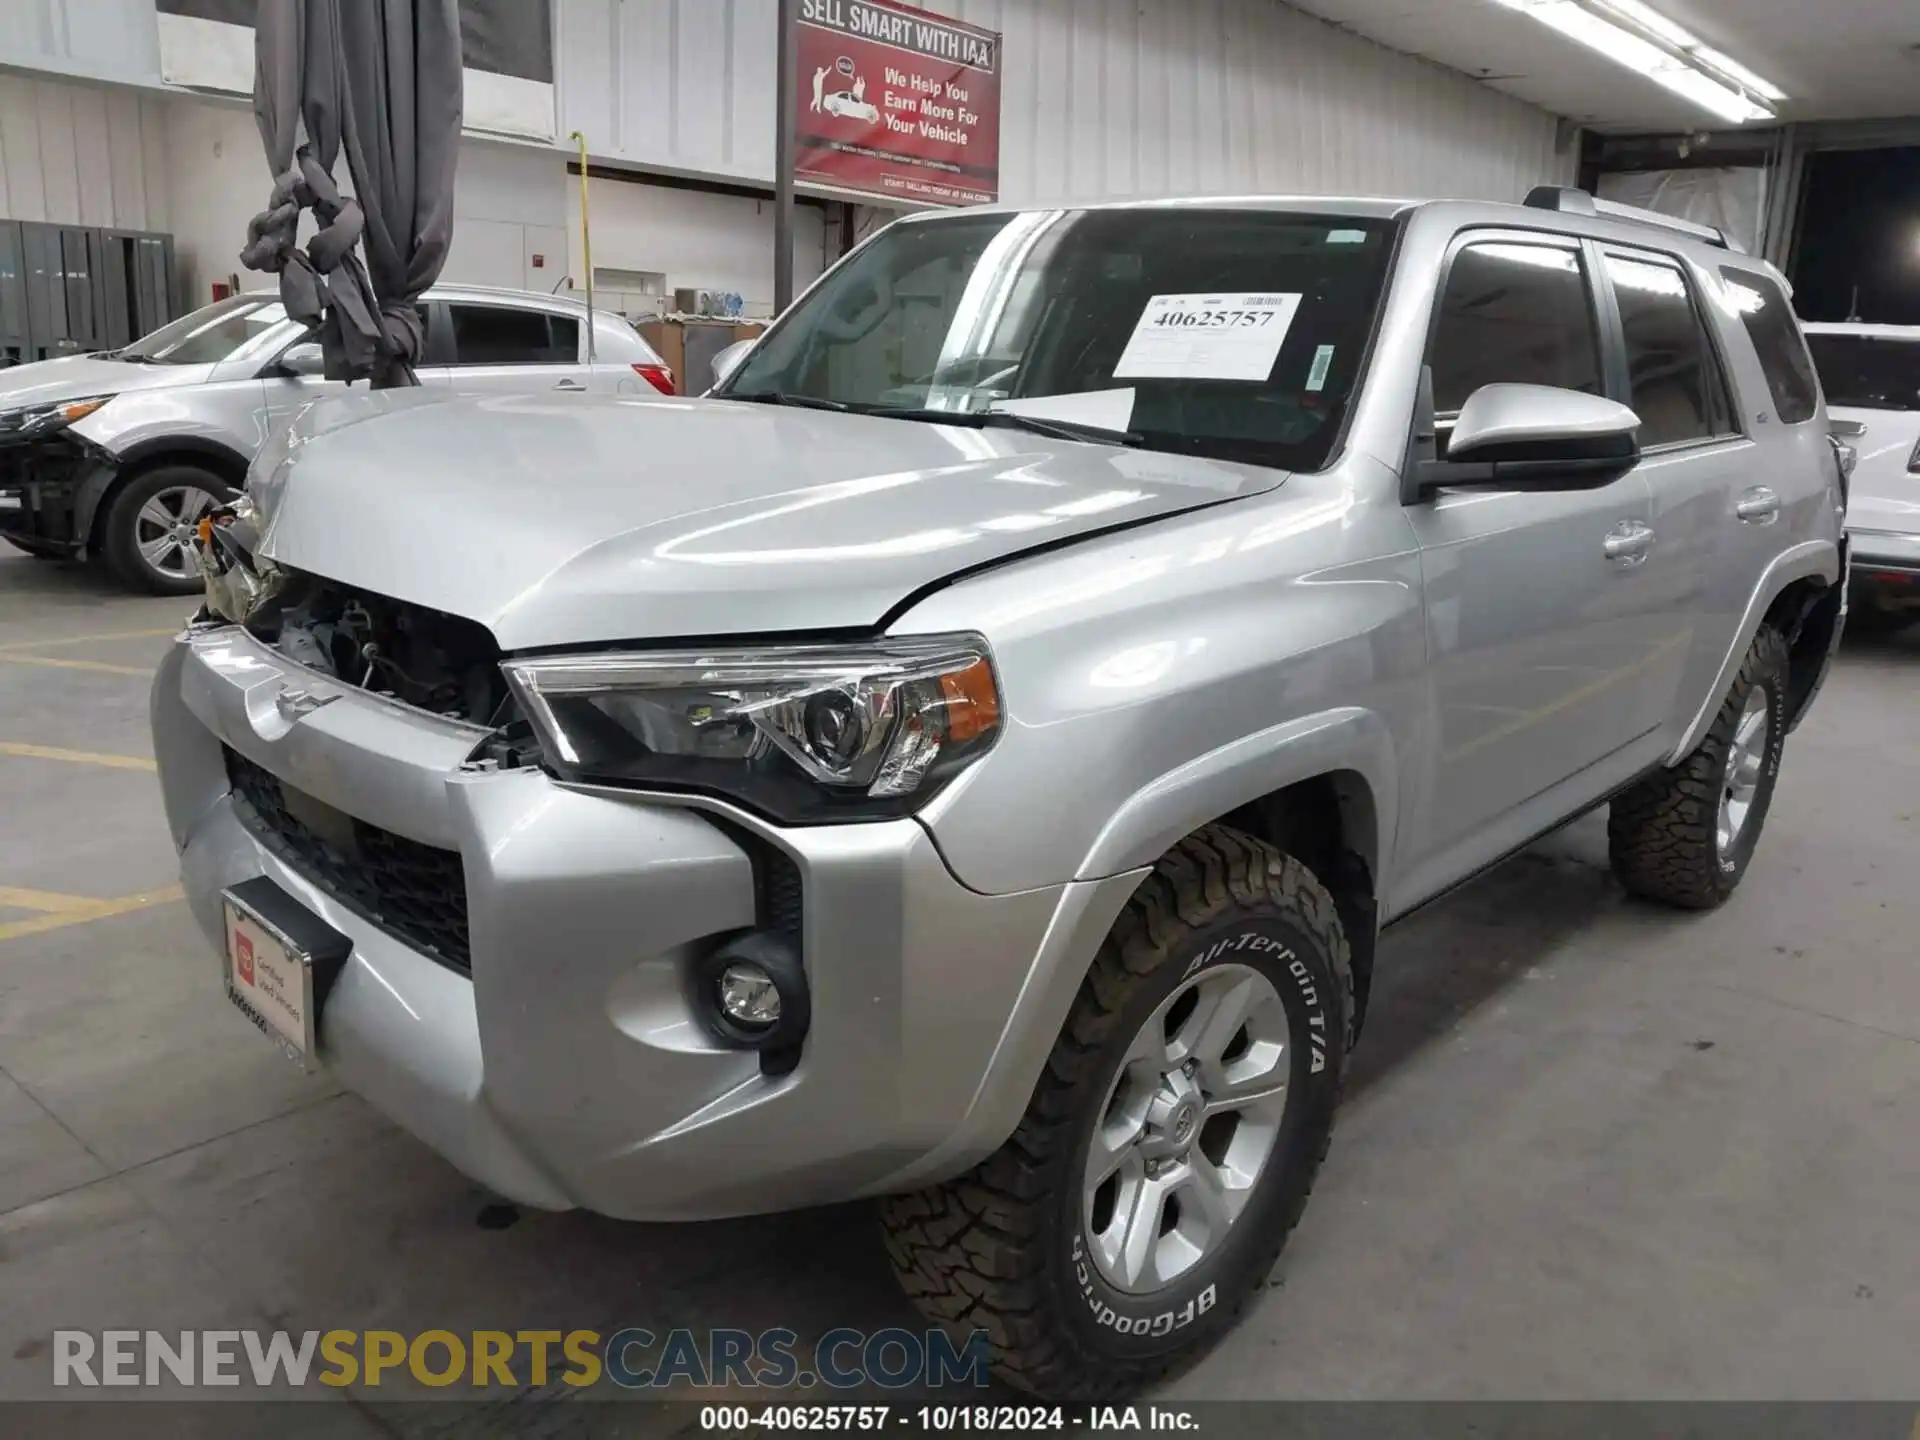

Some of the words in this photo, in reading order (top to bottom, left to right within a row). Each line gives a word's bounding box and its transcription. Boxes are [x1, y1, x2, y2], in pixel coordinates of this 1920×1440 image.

[803, 0, 845, 28] SELL
[850, 5, 913, 46] SMART
[916, 24, 959, 58] WITH
[963, 39, 989, 66] IAA
[884, 66, 906, 87] We
[910, 74, 942, 97] Help
[945, 81, 969, 102] You
[884, 90, 916, 112] Earn
[920, 98, 954, 120] More
[958, 107, 979, 126] For
[884, 112, 916, 134] Your
[919, 120, 968, 145] Vehicle
[1154, 311, 1275, 327] 40625757
[1309, 1008, 1326, 1074] T/A
[1072, 1234, 1216, 1337] BFGoodrich
